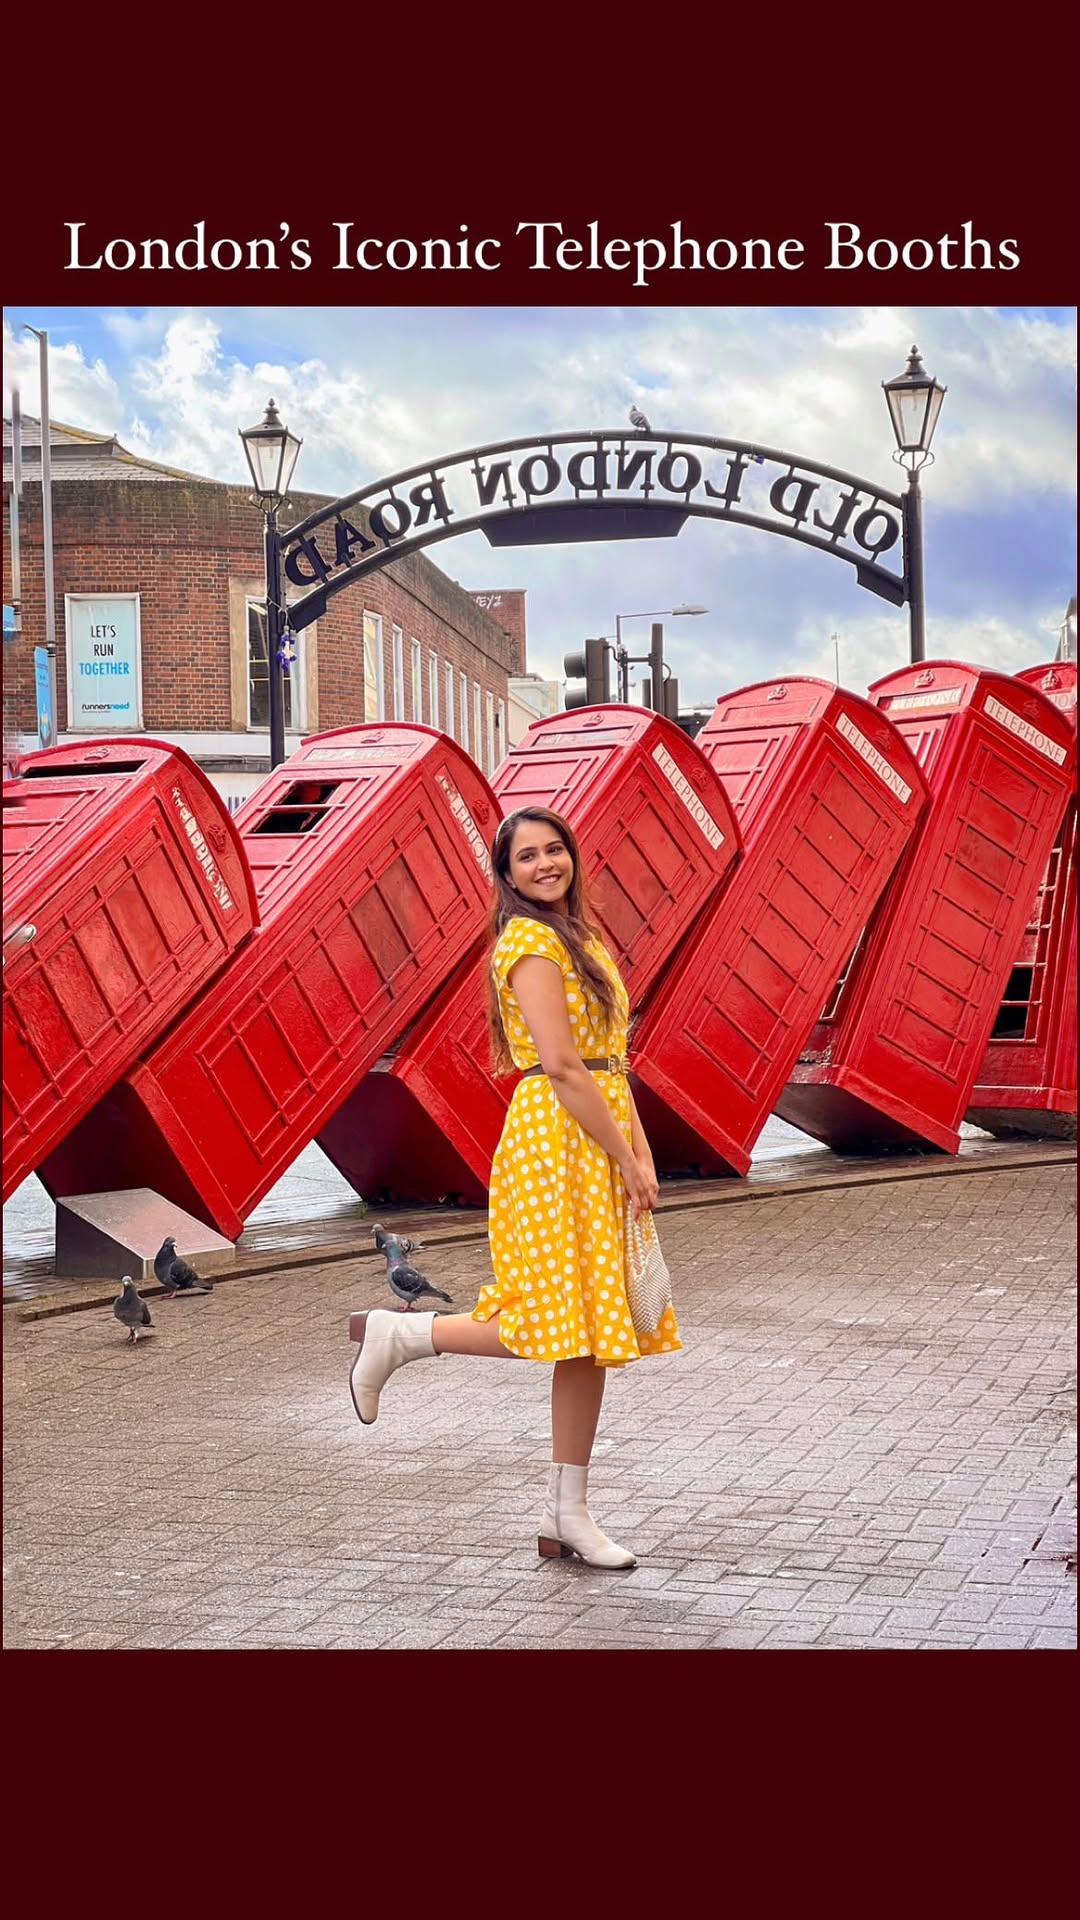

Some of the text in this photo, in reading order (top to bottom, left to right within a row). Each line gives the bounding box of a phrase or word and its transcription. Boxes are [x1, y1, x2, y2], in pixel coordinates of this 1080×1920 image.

[90, 625, 116, 638] LET'S
[93, 643, 114, 657] RUN
[79, 661, 130, 676] TOGETHER
[986, 698, 1064, 762] TELEPHONE
[840, 717, 909, 801] TELEPHONE
[655, 748, 723, 846] TELEPHONE
